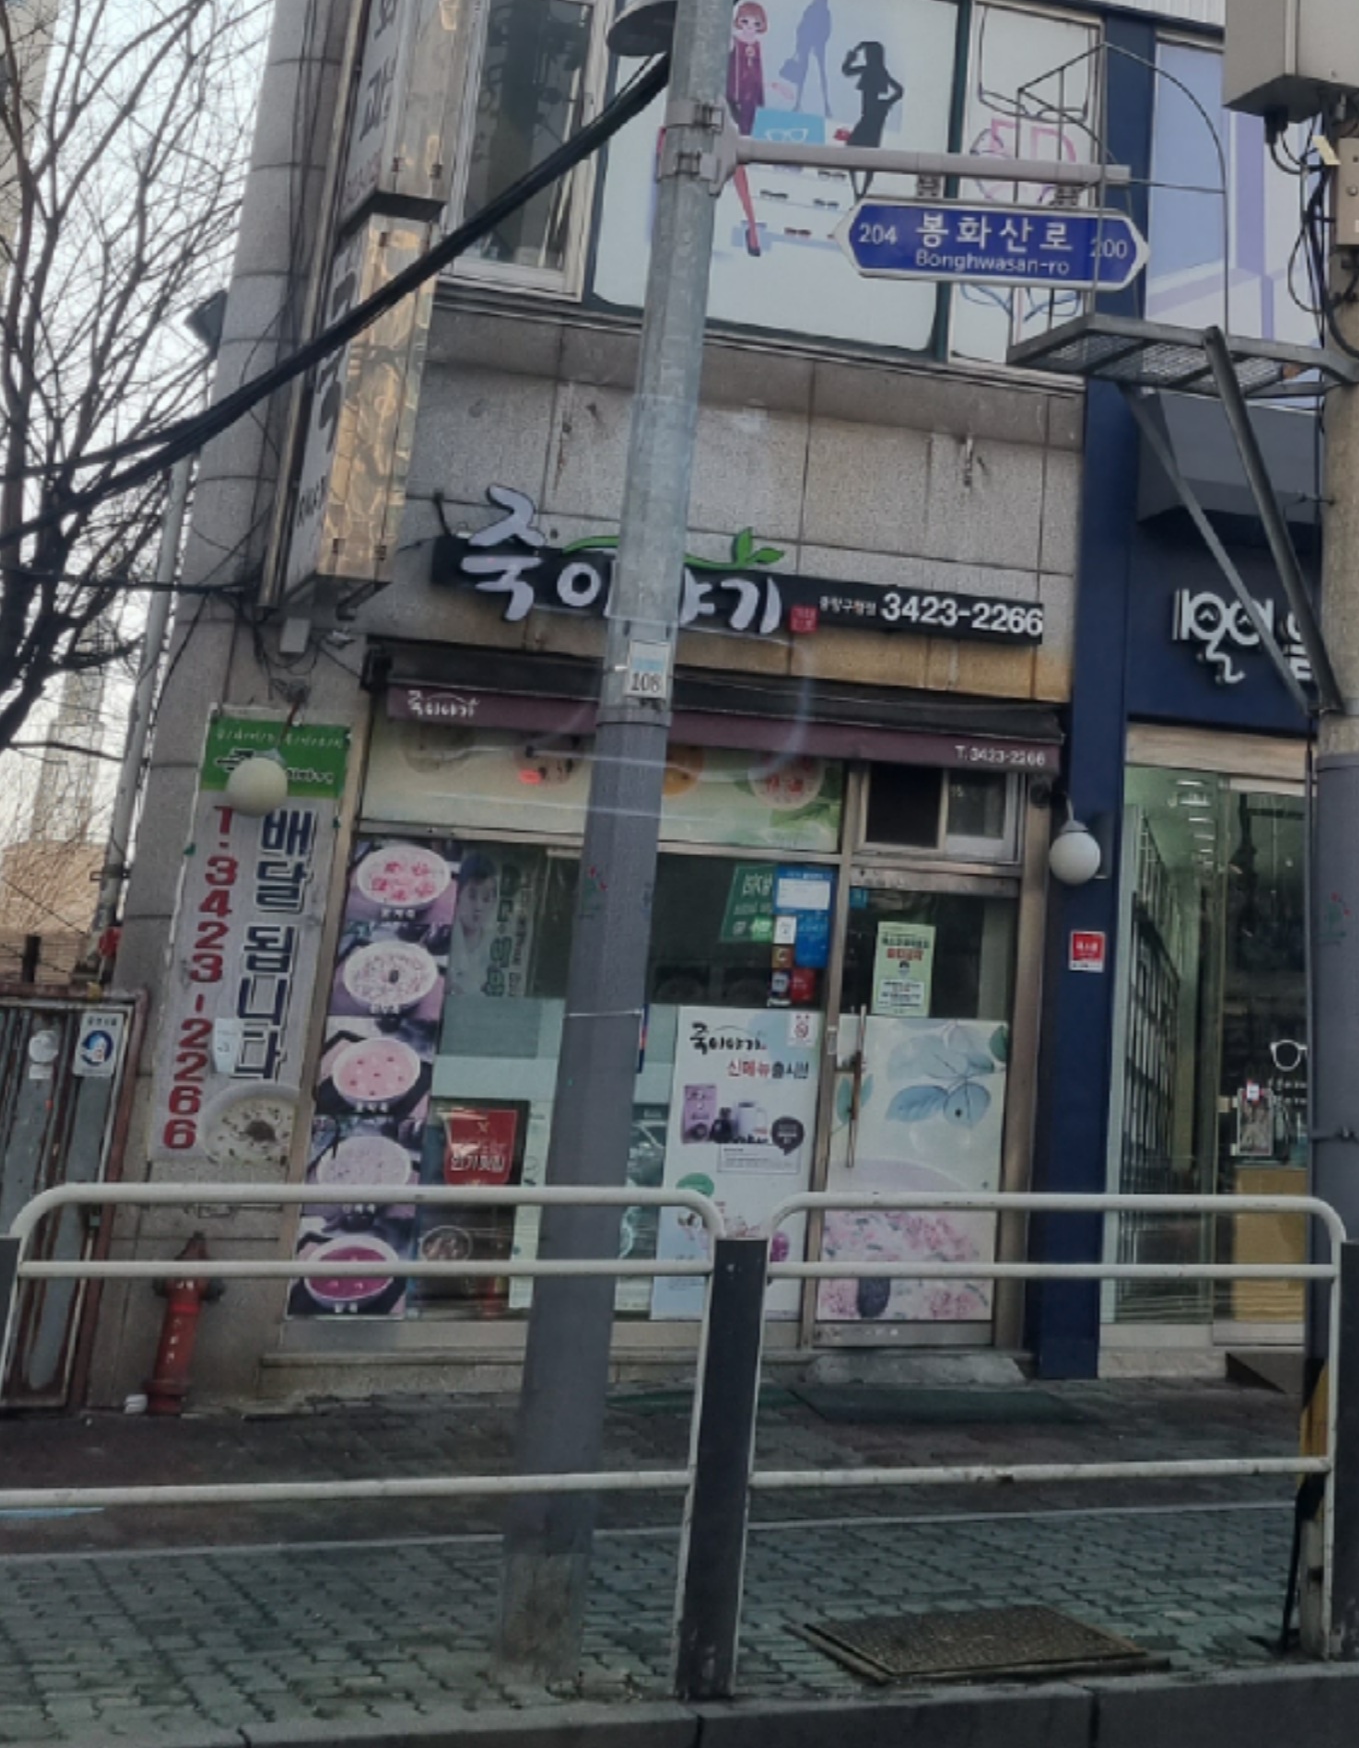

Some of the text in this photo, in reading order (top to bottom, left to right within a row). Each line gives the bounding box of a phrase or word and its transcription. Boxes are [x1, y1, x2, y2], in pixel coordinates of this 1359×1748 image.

[859, 211, 1128, 260] 204 봉화산로 200
[915, 248, 1070, 275] Bonghwasan-ro
[881, 592, 1044, 636] 3423-2266
[630, 672, 661, 693] 108
[255, 809, 315, 914] 배달
[232, 925, 297, 1081] 됩니다
[689, 1021, 761, 1055] 죽이야기
